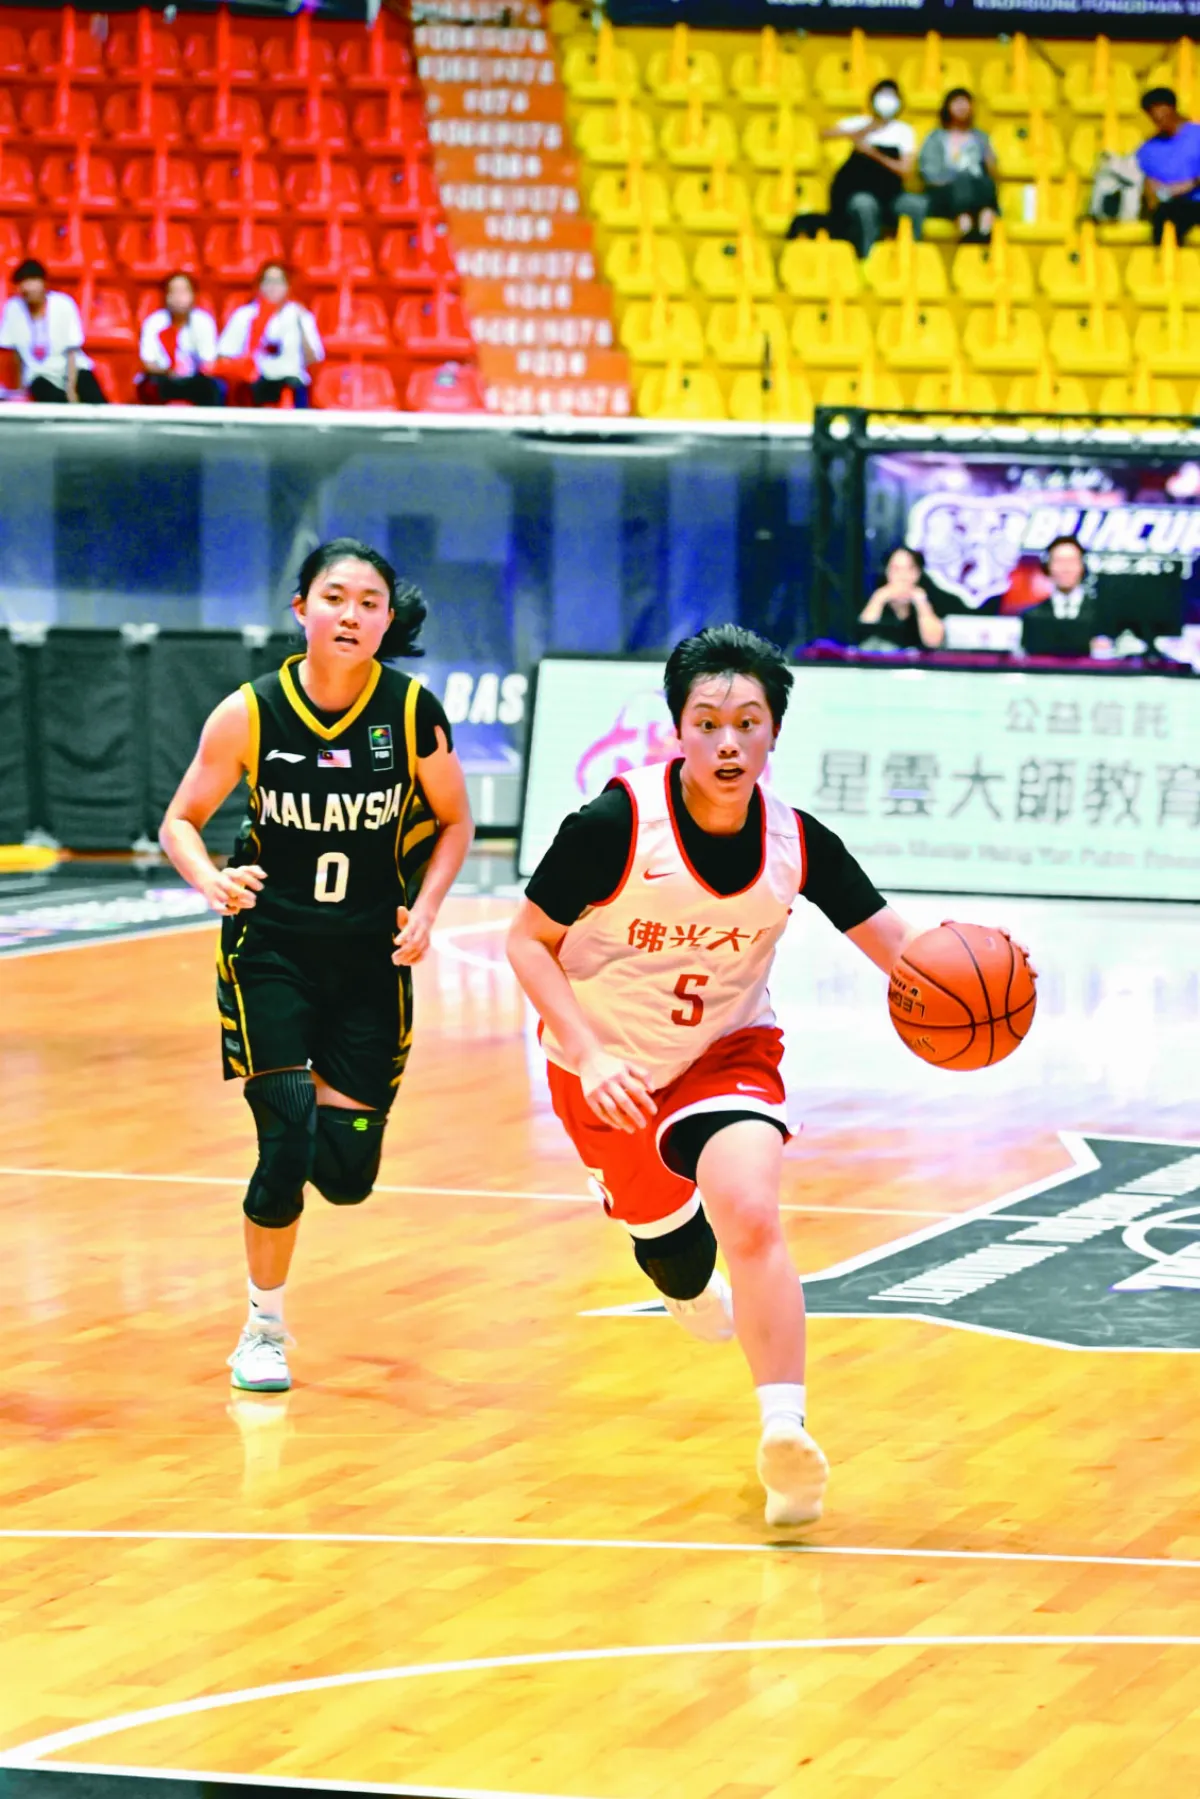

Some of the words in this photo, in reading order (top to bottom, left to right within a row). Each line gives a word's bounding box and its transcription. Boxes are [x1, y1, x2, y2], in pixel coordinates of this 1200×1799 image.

[259, 783, 402, 832] MALAYSIA
[314, 852, 349, 903] 0
[671, 973, 710, 1027] 5
